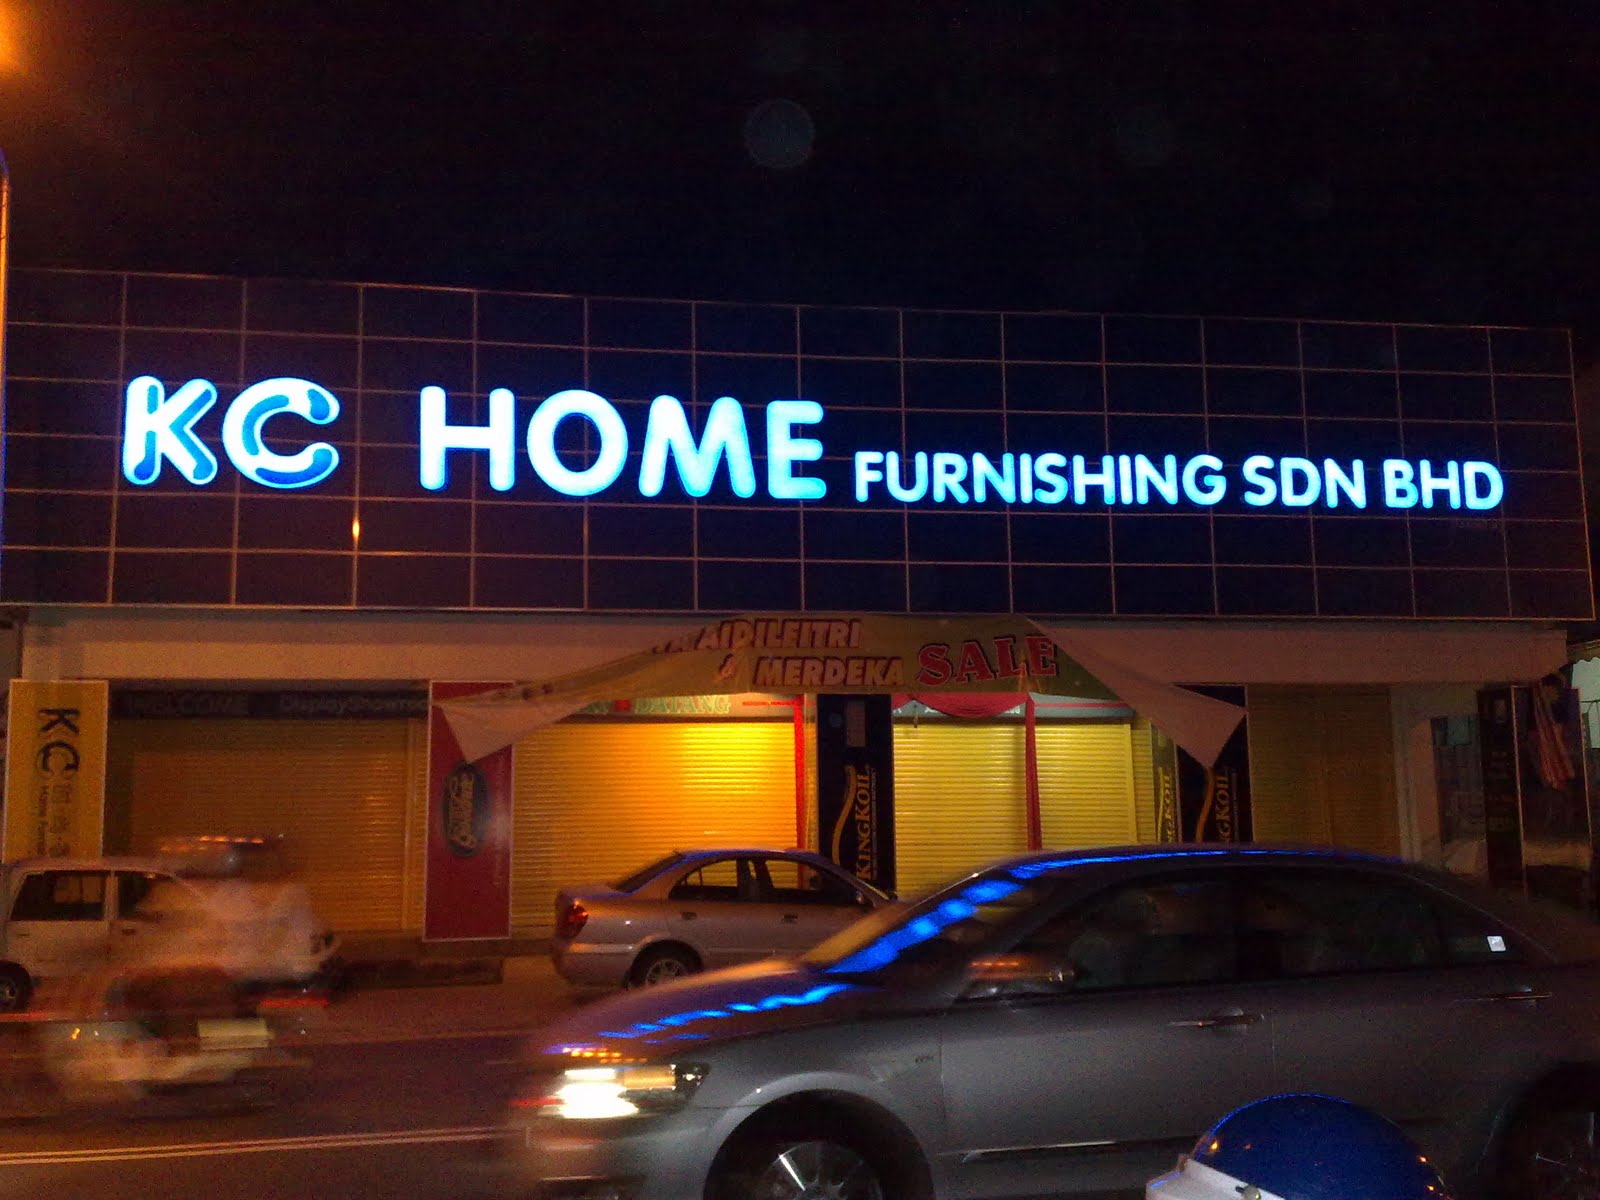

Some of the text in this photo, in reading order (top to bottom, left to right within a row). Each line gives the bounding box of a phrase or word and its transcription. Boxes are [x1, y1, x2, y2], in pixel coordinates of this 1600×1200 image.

[122, 375, 1505, 511] KC HOME FURNISHING SDN BHD
[753, 656, 904, 687] MERDEKA
[917, 634, 1058, 687] SALE
[634, 694, 730, 714] DATANG
[36, 708, 81, 781] KC
